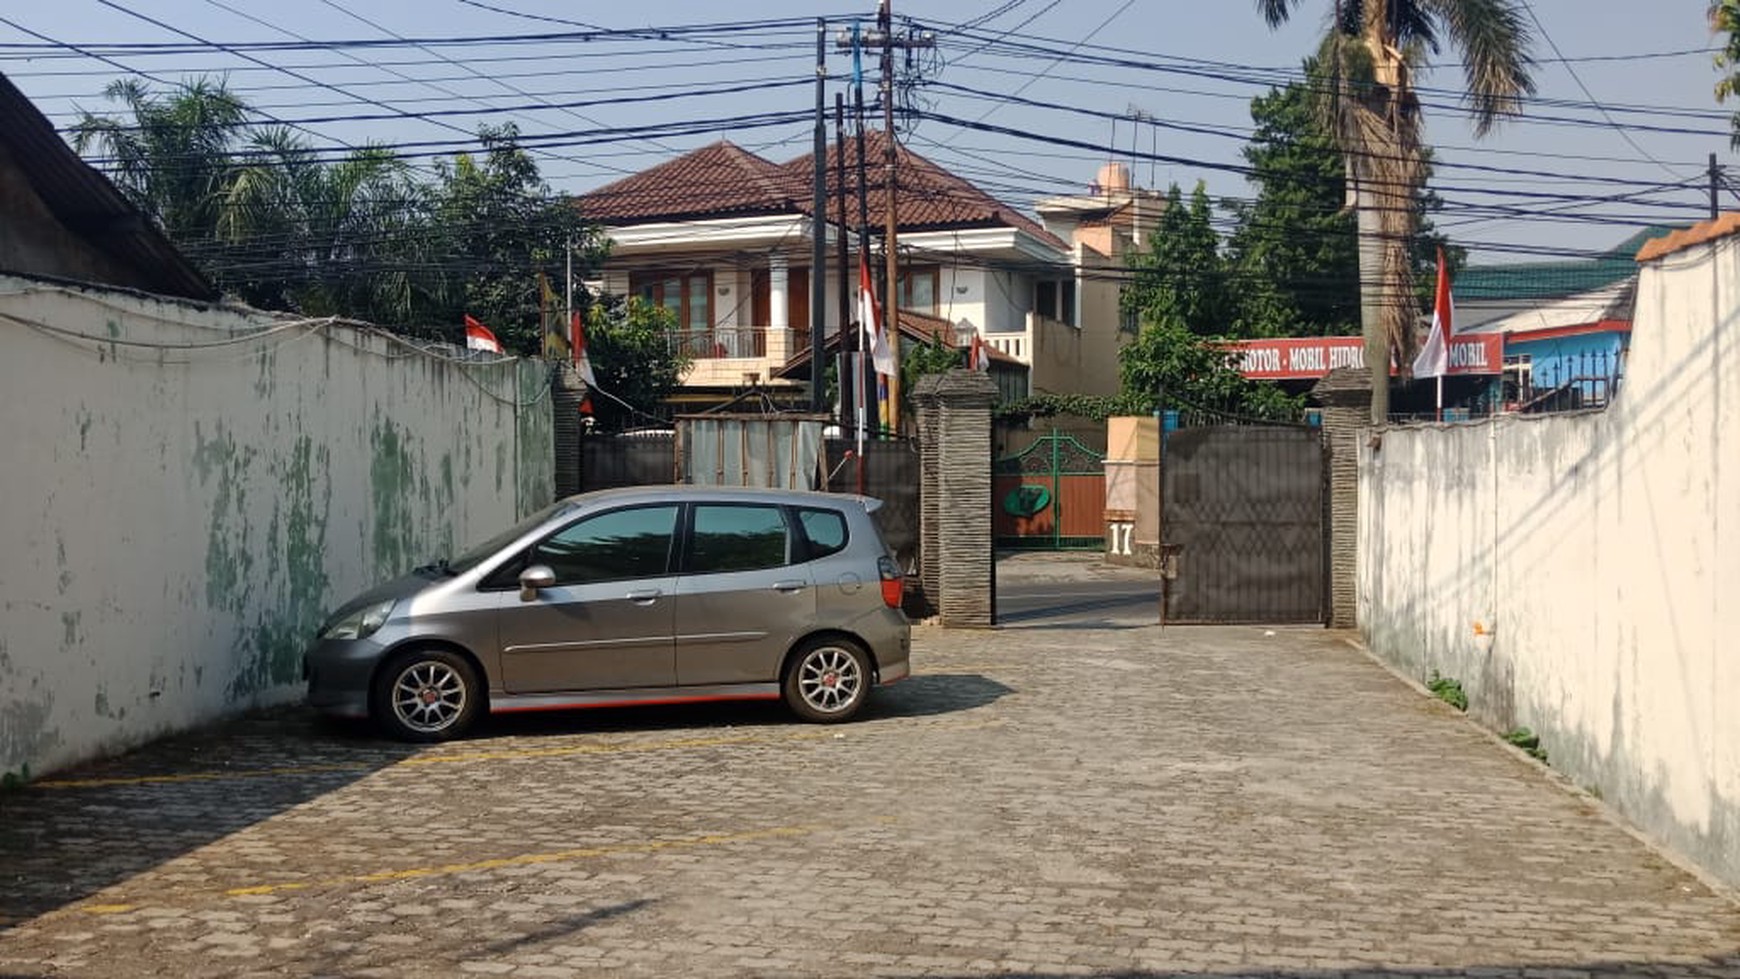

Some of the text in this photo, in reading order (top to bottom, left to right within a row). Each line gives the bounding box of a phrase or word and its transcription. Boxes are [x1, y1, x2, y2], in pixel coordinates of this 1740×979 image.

[1289, 347, 1326, 370] MOBIL
[1449, 343, 1488, 367] MOBIL
[1110, 524, 1133, 555] 17
